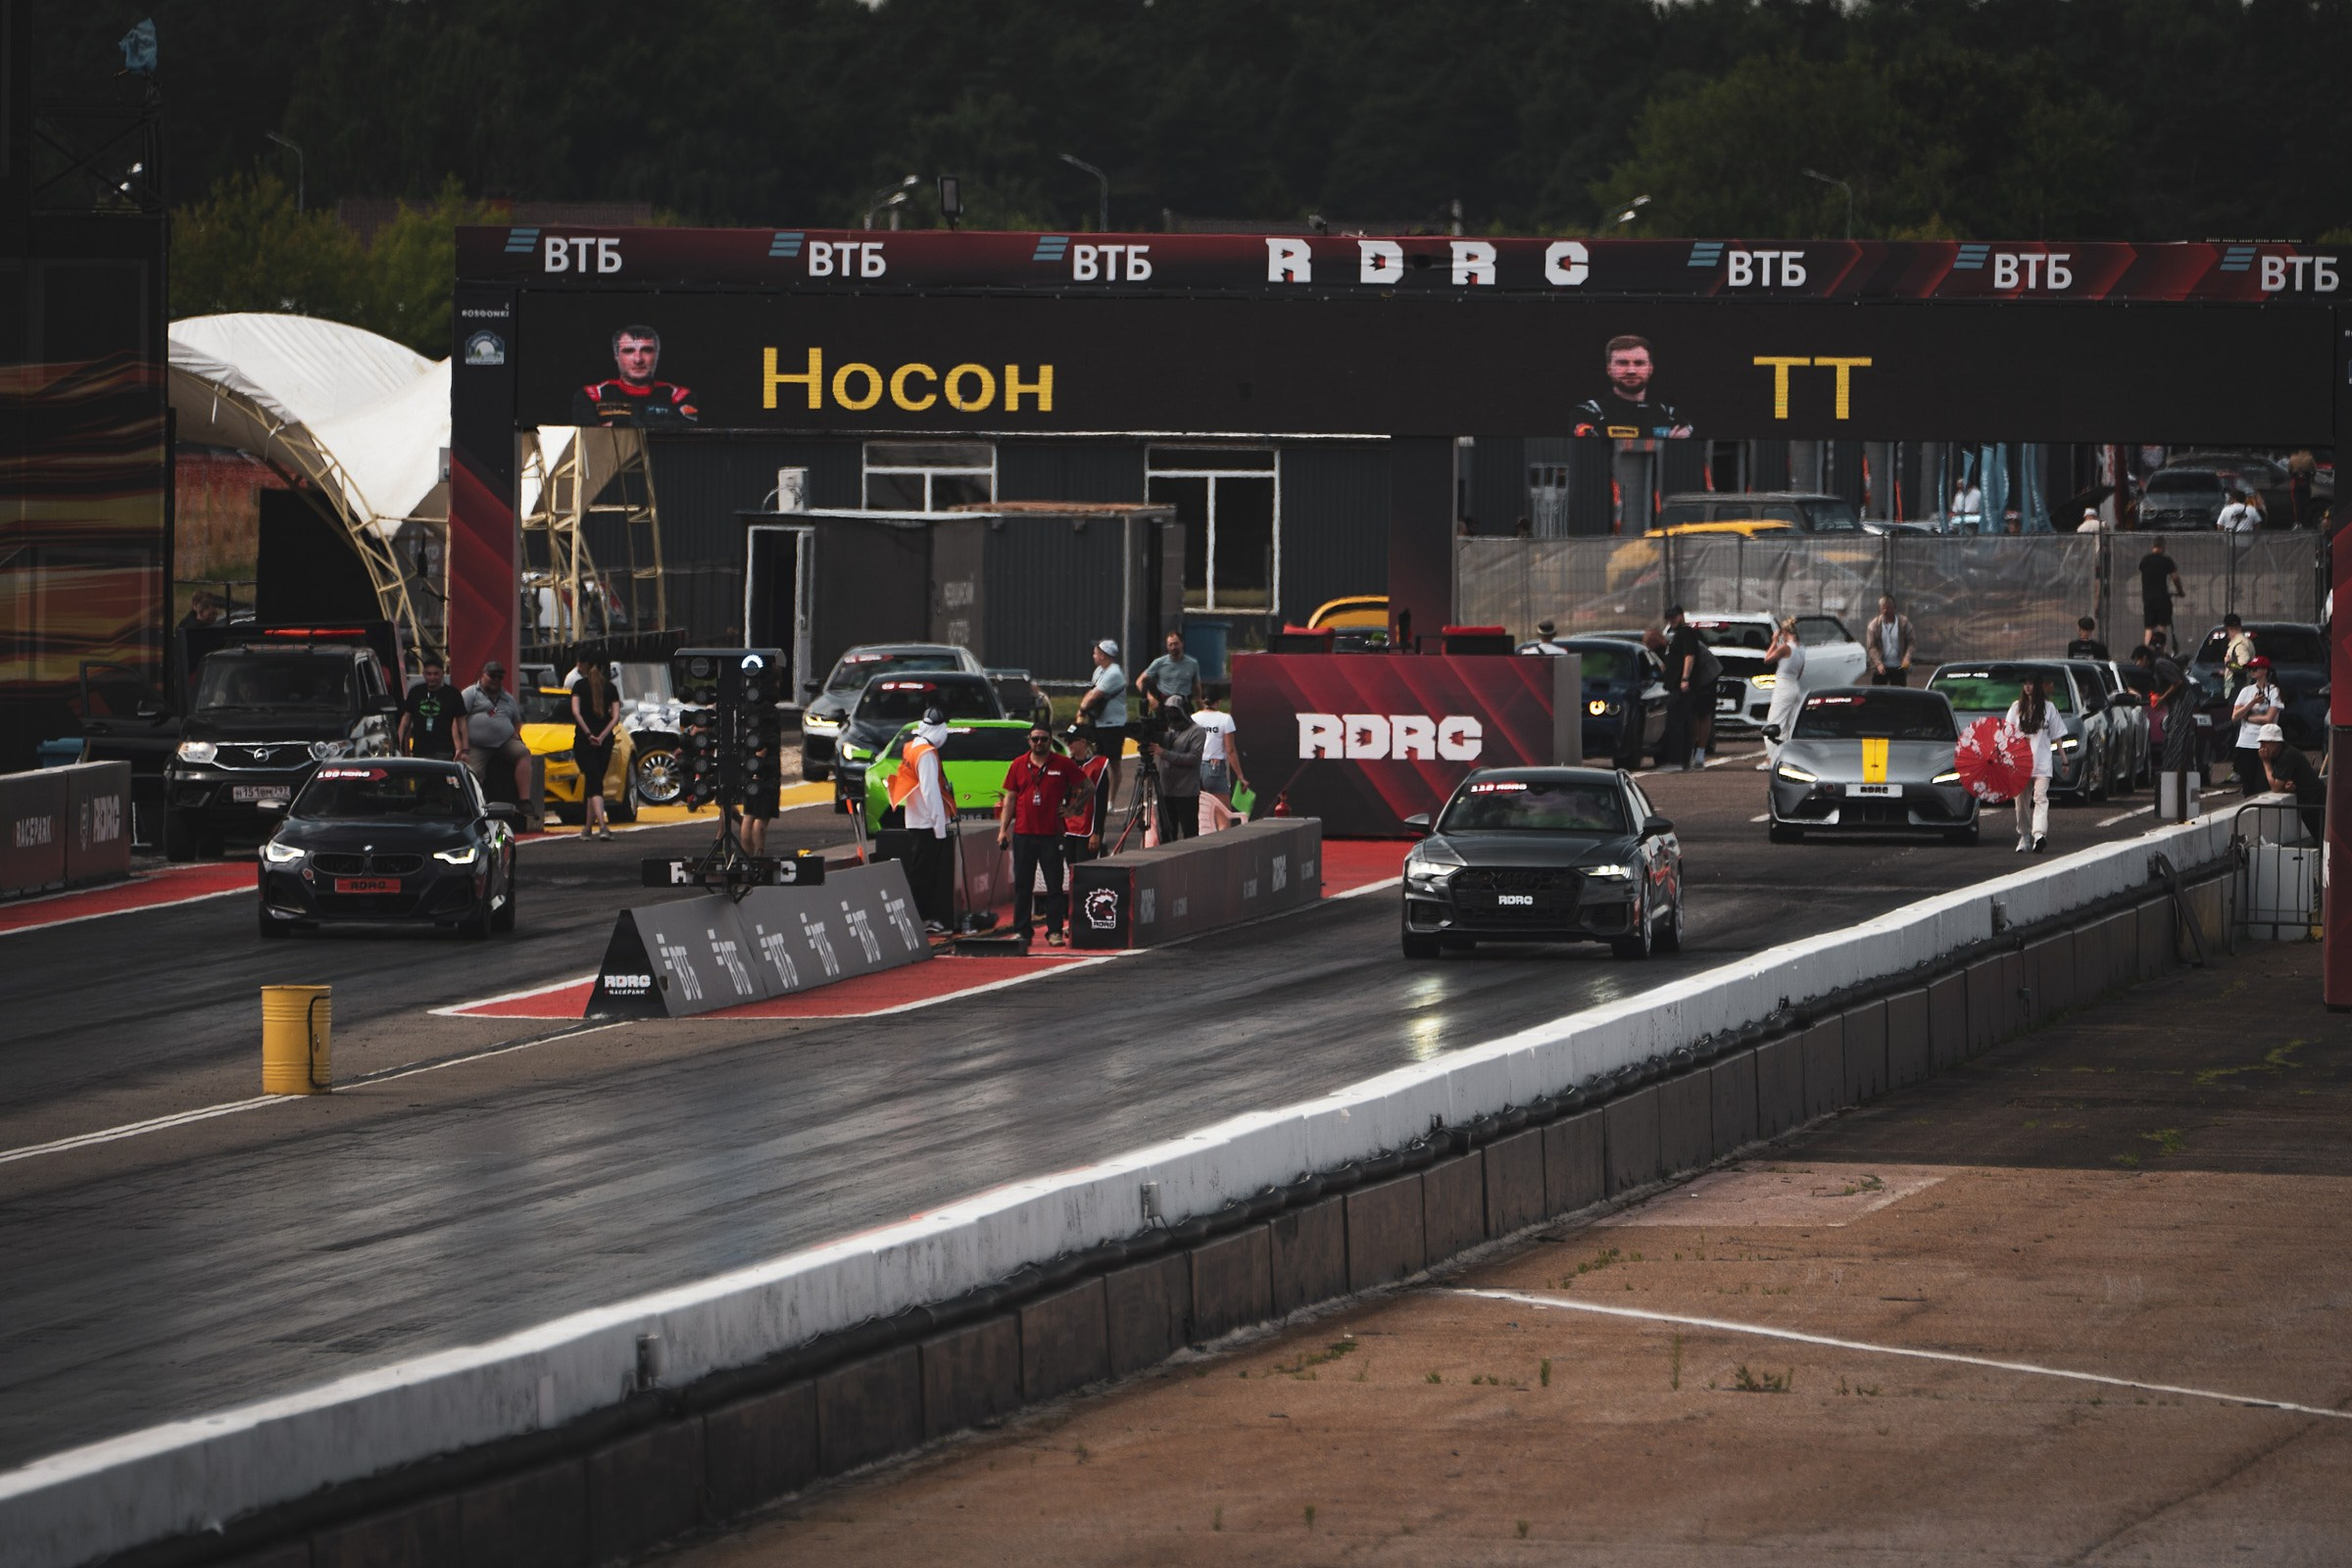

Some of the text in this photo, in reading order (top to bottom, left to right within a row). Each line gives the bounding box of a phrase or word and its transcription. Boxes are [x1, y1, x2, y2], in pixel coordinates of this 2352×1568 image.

[545, 237, 622, 273] ВТБ
[808, 241, 887, 278] ВТБ
[1073, 245, 1152, 281] ВТБ
[1728, 250, 1807, 287] ВТБ
[1993, 253, 2073, 289] ВТБ
[2261, 256, 2339, 291] ВТБ
[762, 347, 1054, 413] Носон
[1297, 712, 1483, 760] RDRC
[1498, 895, 1534, 906] RDRC
[604, 975, 651, 988] RDRC
